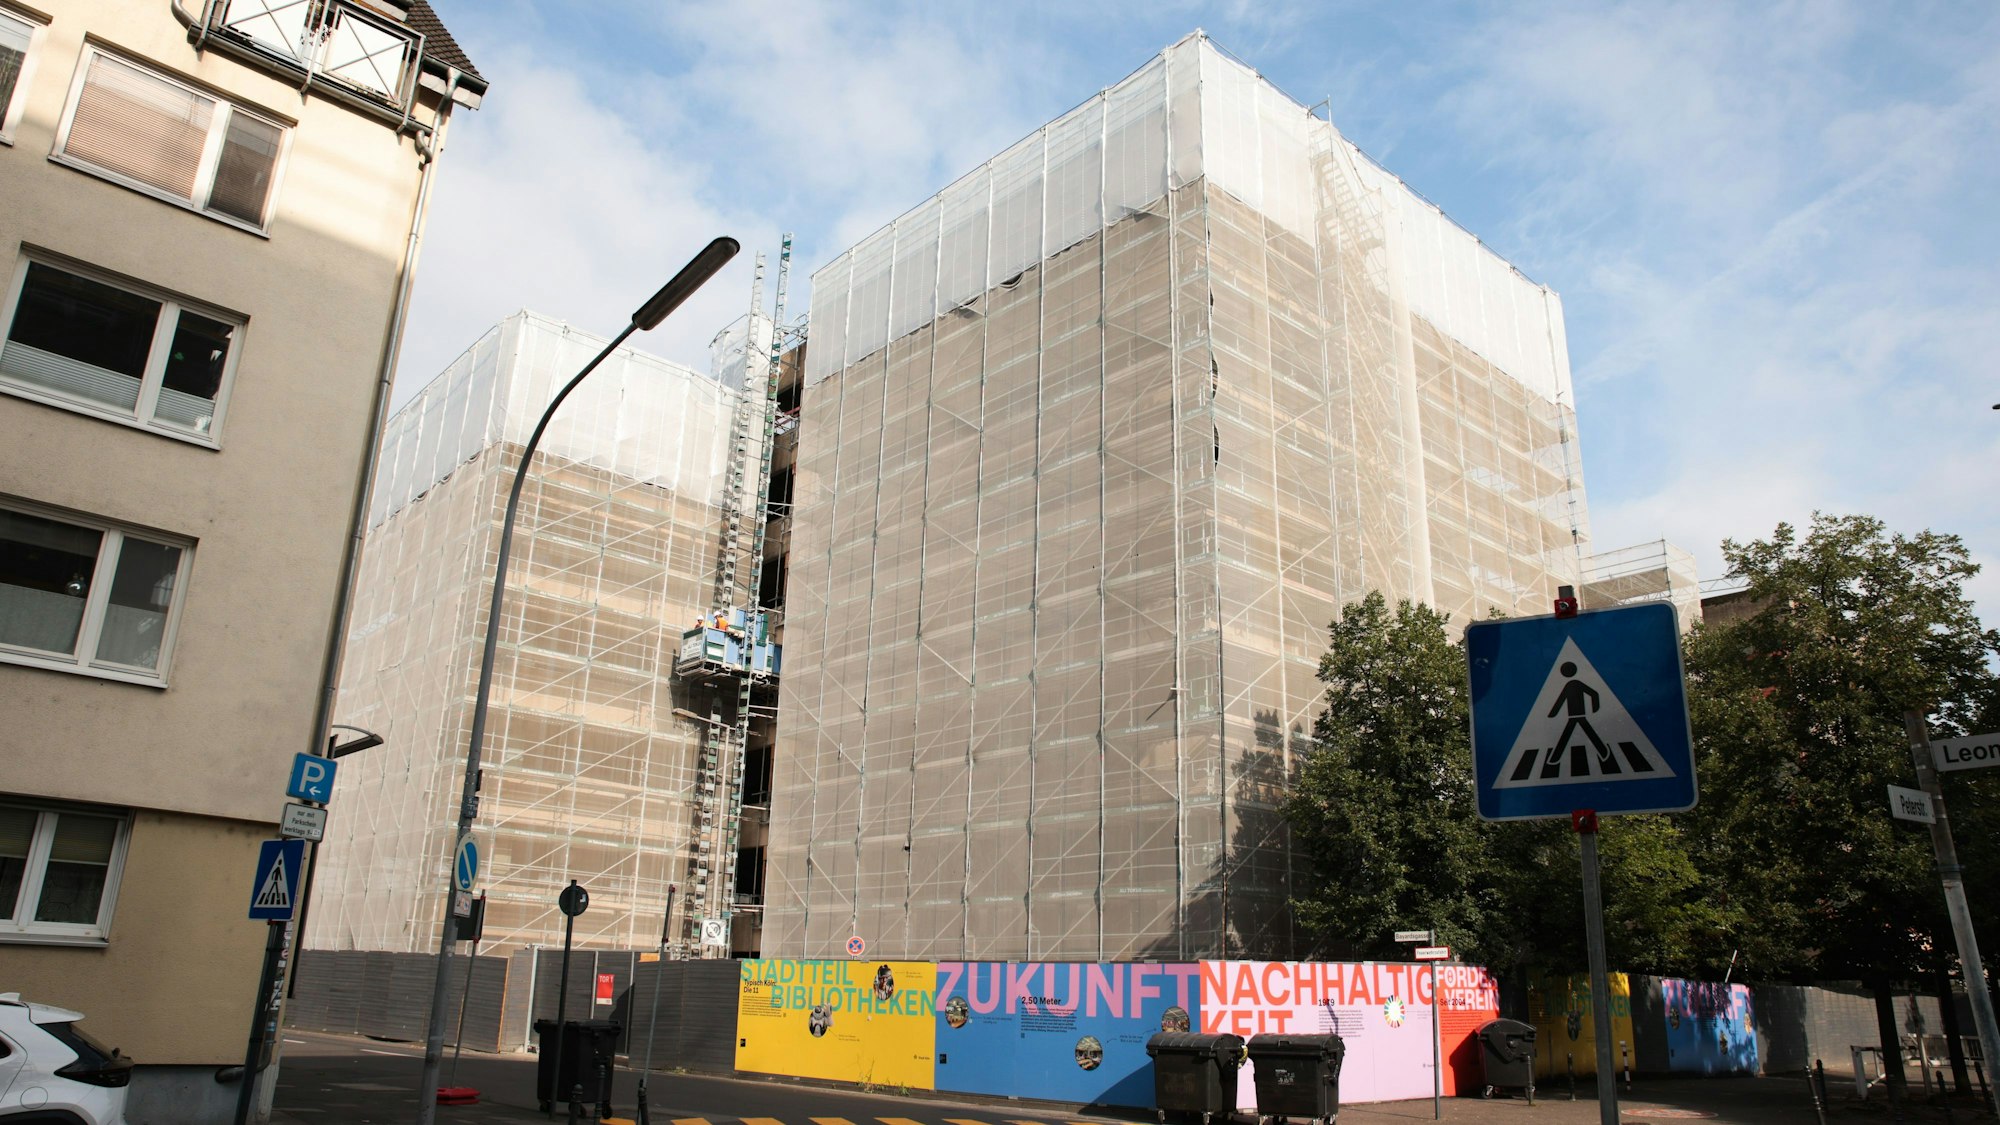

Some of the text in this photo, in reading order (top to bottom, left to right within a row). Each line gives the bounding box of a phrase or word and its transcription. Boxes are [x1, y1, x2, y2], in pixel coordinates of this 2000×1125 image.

[299, 760, 325, 793] P
[1900, 795, 1928, 817] Peterstr.
[284, 827, 306, 836] werktags
[292, 818, 317, 827] Parkschein
[1395, 932, 1432, 940] Bayardsgasse
[741, 959, 853, 985] STADTTEIL
[744, 979, 763, 987] Typisch
[1200, 960, 1433, 1006] NACHHALTIG
[771, 986, 936, 1016] BIBLIOTHEKEN
[936, 962, 1200, 1018] ZUKUNFT
[1022, 997, 1061, 1005] 2,50 Meter
[1444, 988, 1500, 1011] VEREIN
